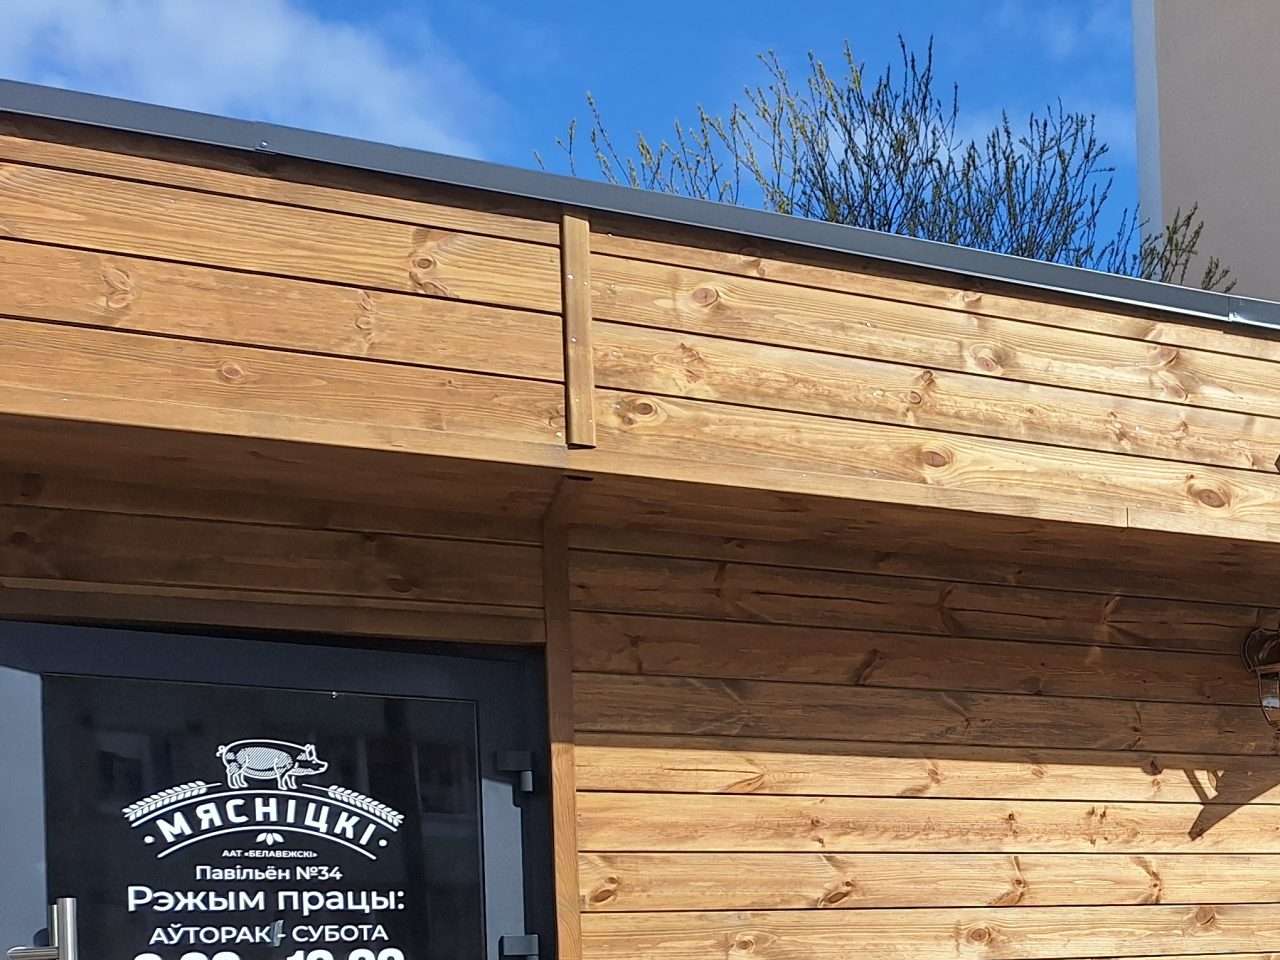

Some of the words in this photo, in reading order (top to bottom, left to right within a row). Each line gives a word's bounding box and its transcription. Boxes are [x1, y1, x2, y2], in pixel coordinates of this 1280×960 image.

[156, 797, 376, 845] МЯСНІЦКІ
[244, 850, 317, 858] «БЕЛАВЕЖСКІ»
[196, 866, 289, 880] Павільён
[296, 866, 342, 880] №34
[128, 886, 264, 912] Рэжым
[278, 890, 404, 915] працы:
[149, 923, 271, 944] АЎТОРАК
[292, 925, 388, 942] СУБОТА
